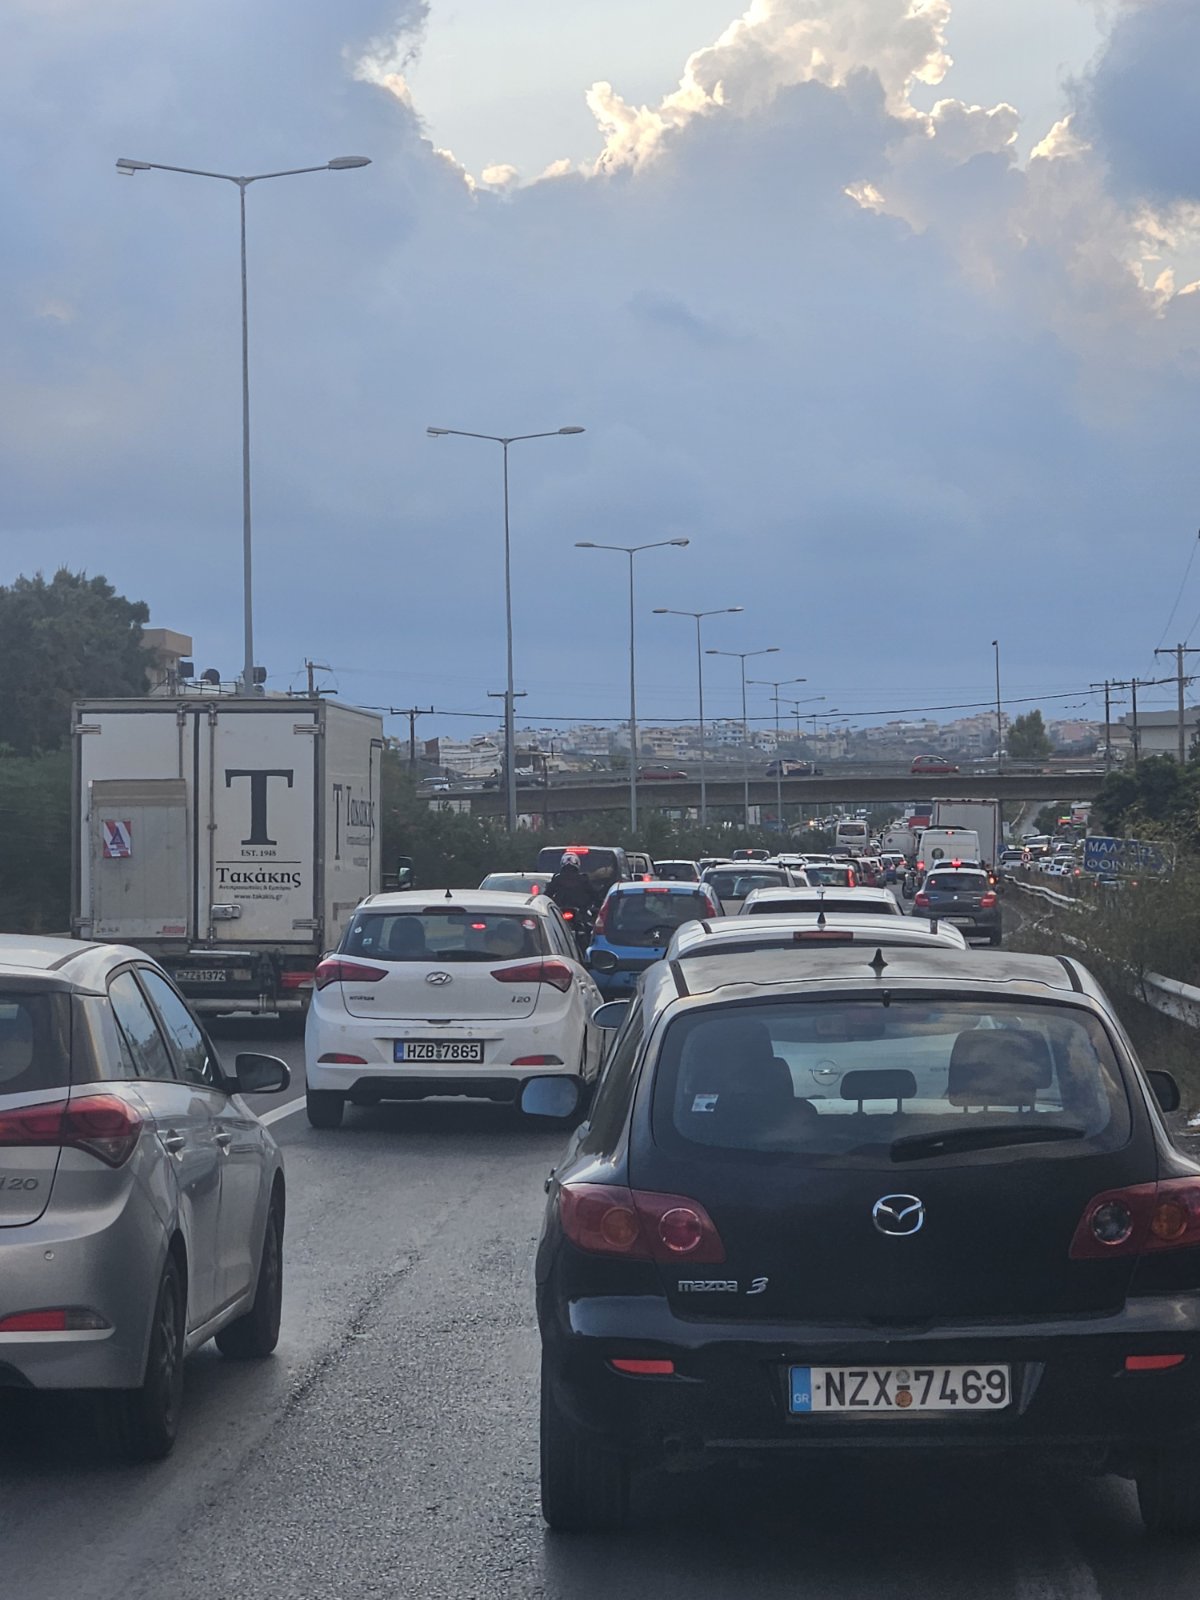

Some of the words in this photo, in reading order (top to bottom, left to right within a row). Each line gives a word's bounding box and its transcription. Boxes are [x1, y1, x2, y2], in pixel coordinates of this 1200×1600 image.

[216, 867, 301, 888] Τακάκης
[678, 1280, 738, 1292] mazda
[746, 1276, 769, 1295] 3
[793, 1393, 809, 1404] GR
